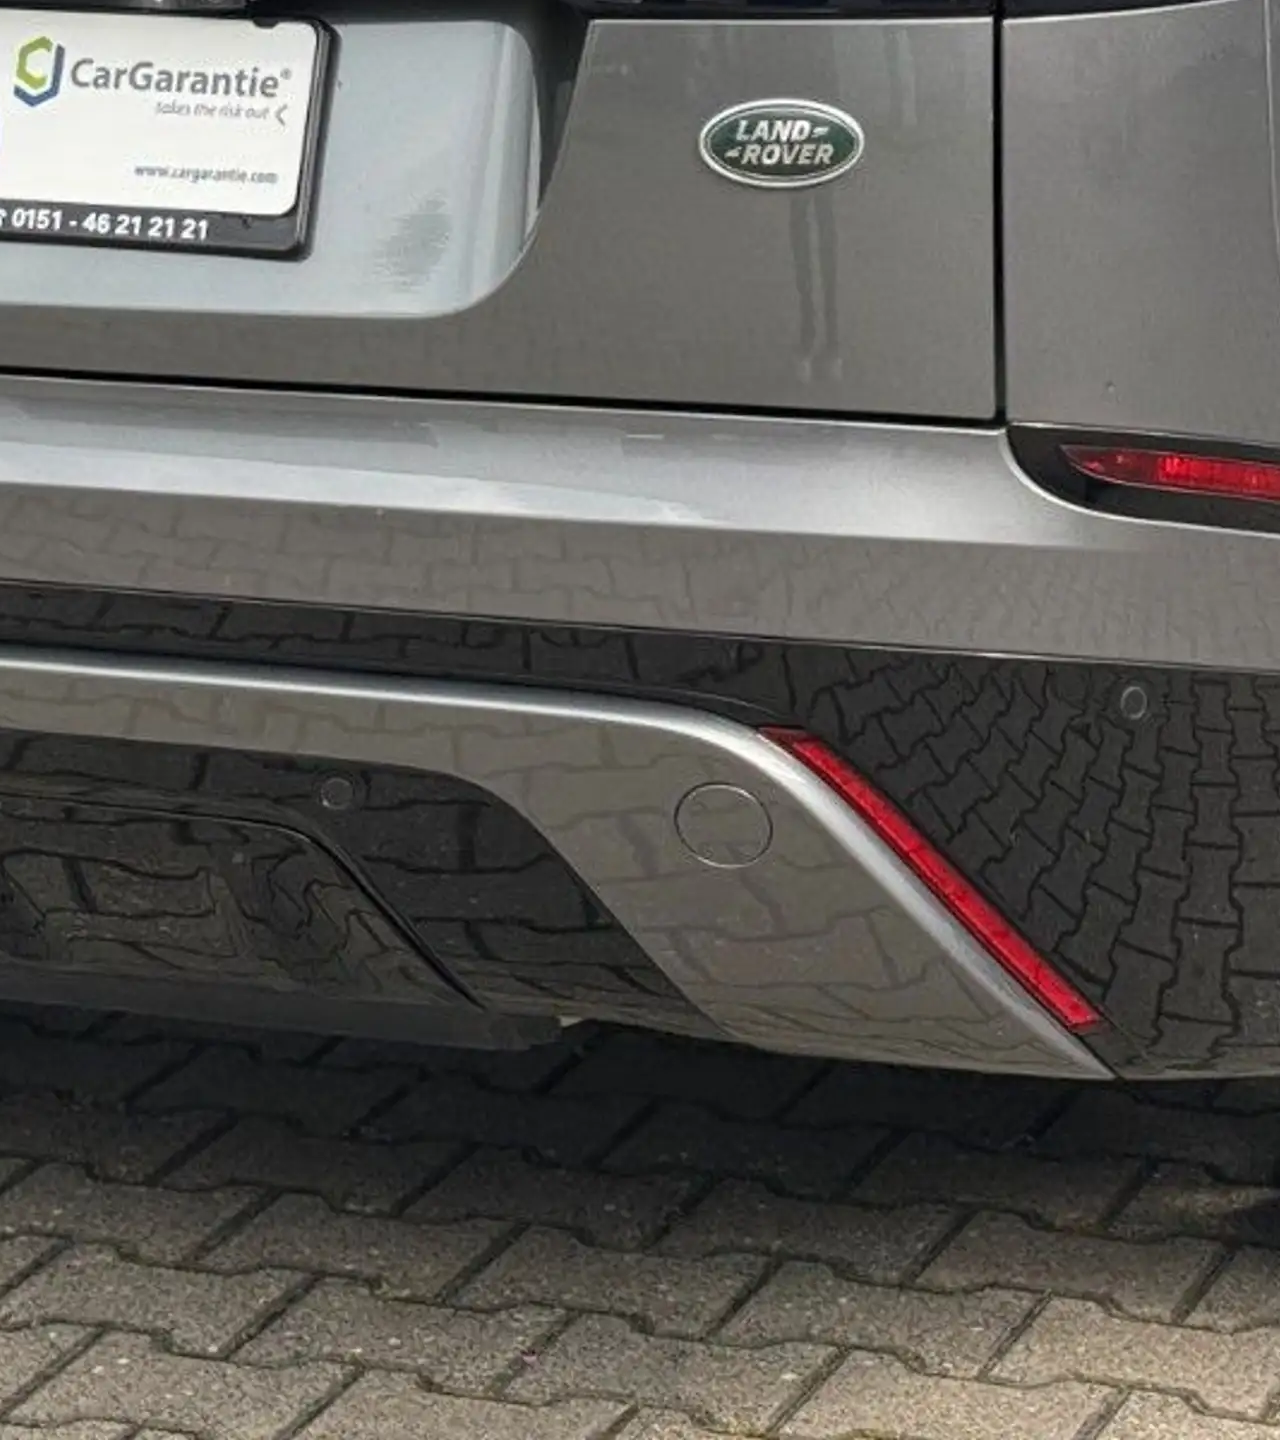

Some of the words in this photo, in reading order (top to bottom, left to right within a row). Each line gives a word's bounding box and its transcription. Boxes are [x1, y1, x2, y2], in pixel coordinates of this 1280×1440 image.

[735, 120, 811, 142] LAND
[740, 144, 834, 165] ROVER
[134, 164, 280, 184] www.cargarantie.com
[11, 208, 62, 231] 0151
[81, 212, 112, 234] 46
[114, 214, 142, 236] 21
[147, 216, 175, 239] 21
[180, 218, 209, 241] 21
